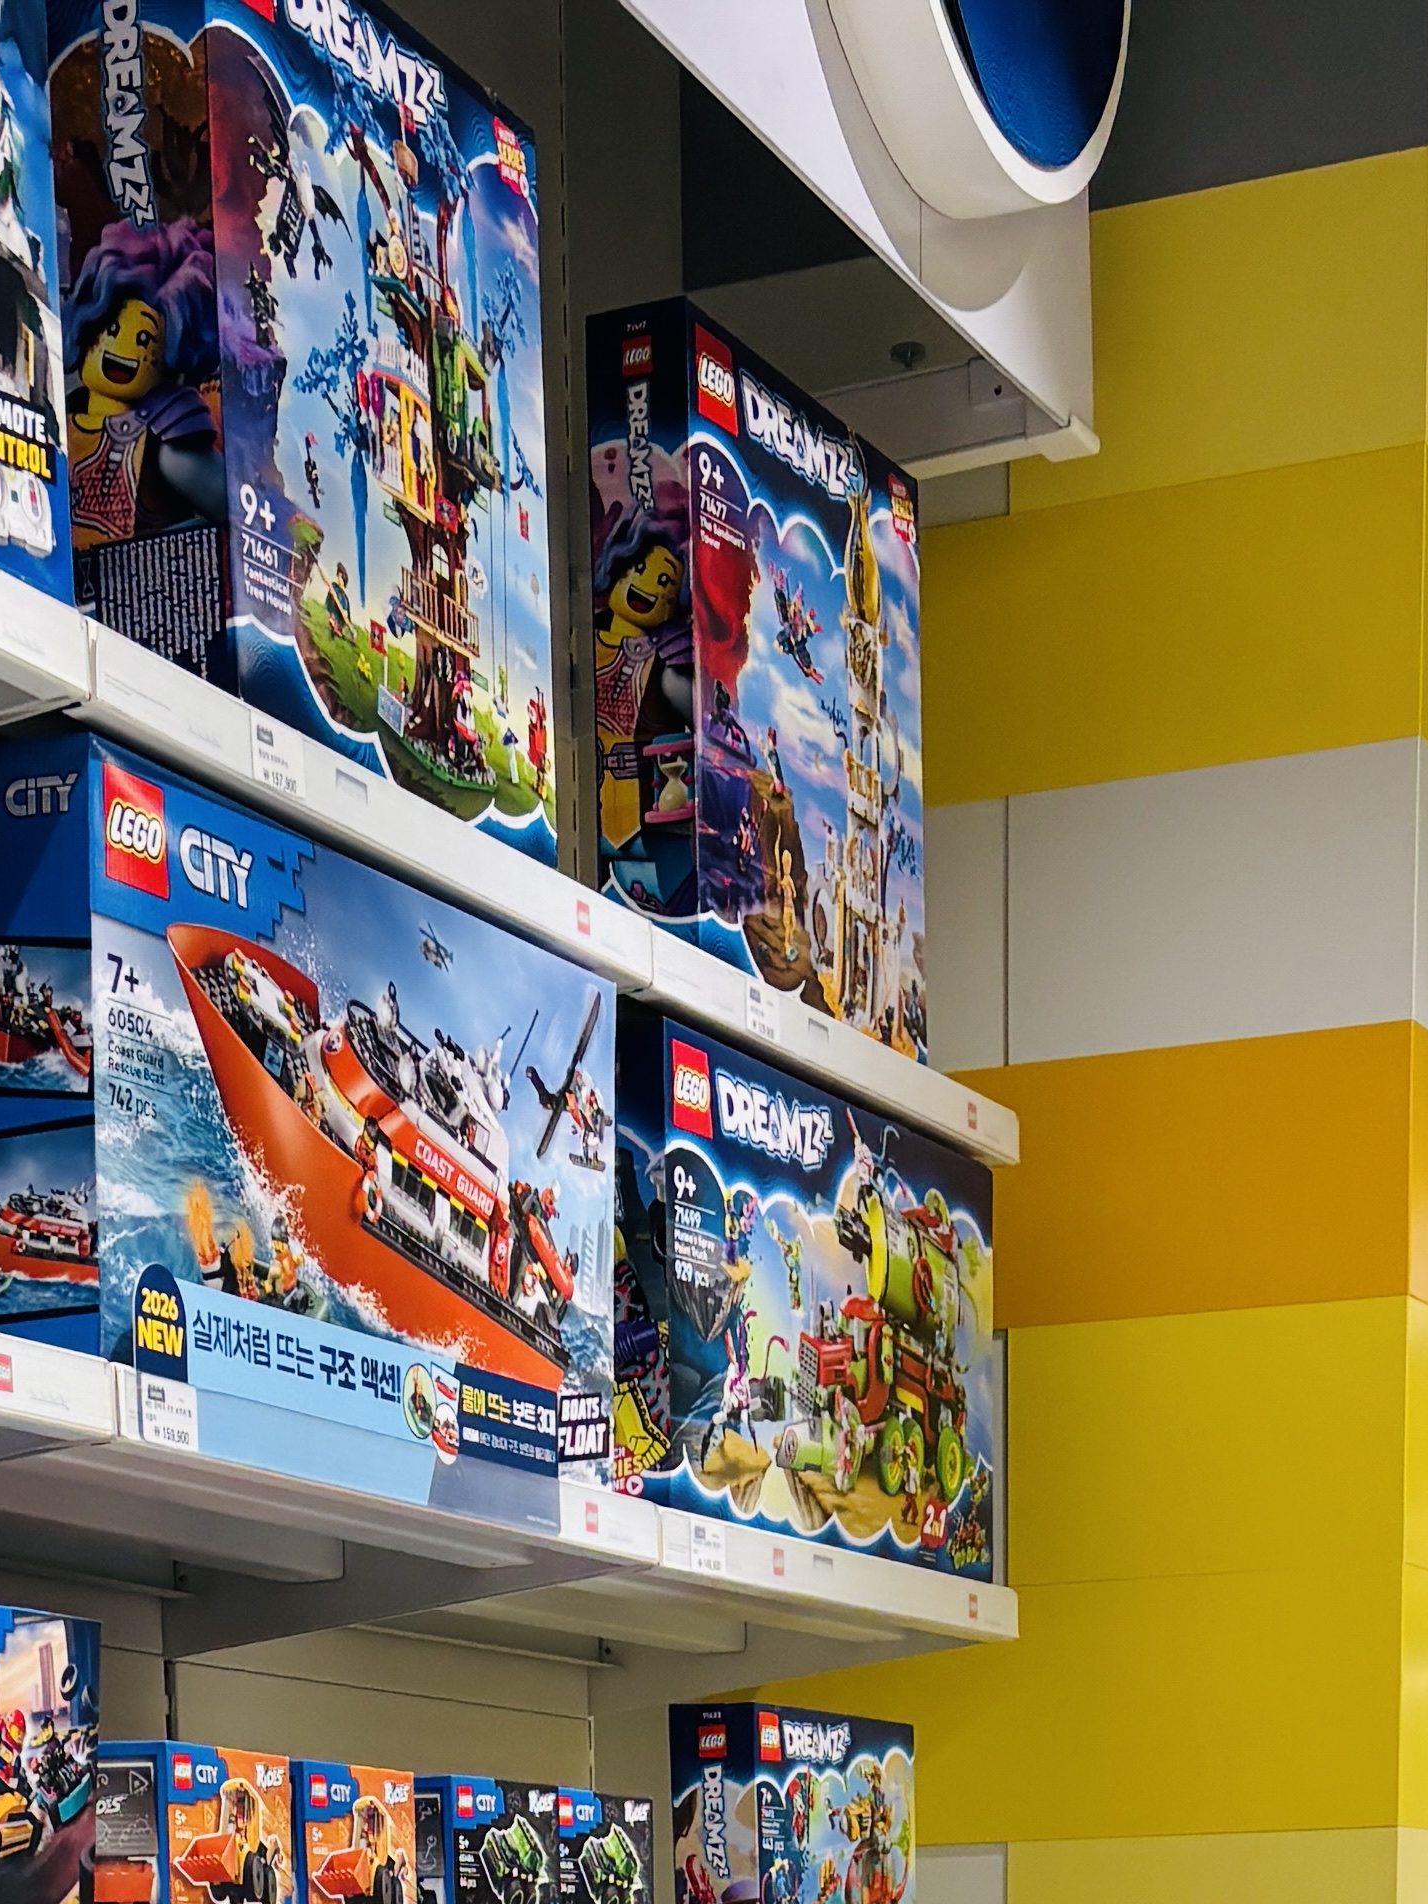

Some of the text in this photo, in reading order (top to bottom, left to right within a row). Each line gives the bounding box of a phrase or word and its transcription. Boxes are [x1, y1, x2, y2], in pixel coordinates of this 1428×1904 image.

[699, 356, 735, 406] LEGO
[698, 457, 725, 490] 9+
[239, 483, 276, 531] 9+
[244, 581, 269, 605] Tree
[6, 772, 79, 817] CITY
[106, 799, 255, 909] LEGO CITY
[106, 953, 140, 994] 7+
[107, 1006, 154, 1039] 60504
[107, 1040, 165, 1070] Coast Guard
[107, 1056, 141, 1079] Rescue
[107, 1083, 158, 1120] 742 pcs
[675, 1069, 709, 1111] LEGO
[414, 1138, 496, 1214] COAST GUARD
[673, 1166, 697, 1200] 9+
[674, 1258, 692, 1284] 929
[140, 1287, 180, 1322] 2026
[137, 1317, 184, 1358] NEW
[192, 1313, 402, 1405] 실제처럼 뜨는 구조 액션!
[462, 1384, 486, 1418] 물에
[487, 1389, 512, 1425] 뜨는
[513, 1398, 537, 1432] 보트
[561, 1395, 601, 1423] BOATS
[557, 1422, 608, 1456] FLOAT
[699, 1734, 727, 1750] LEGO
